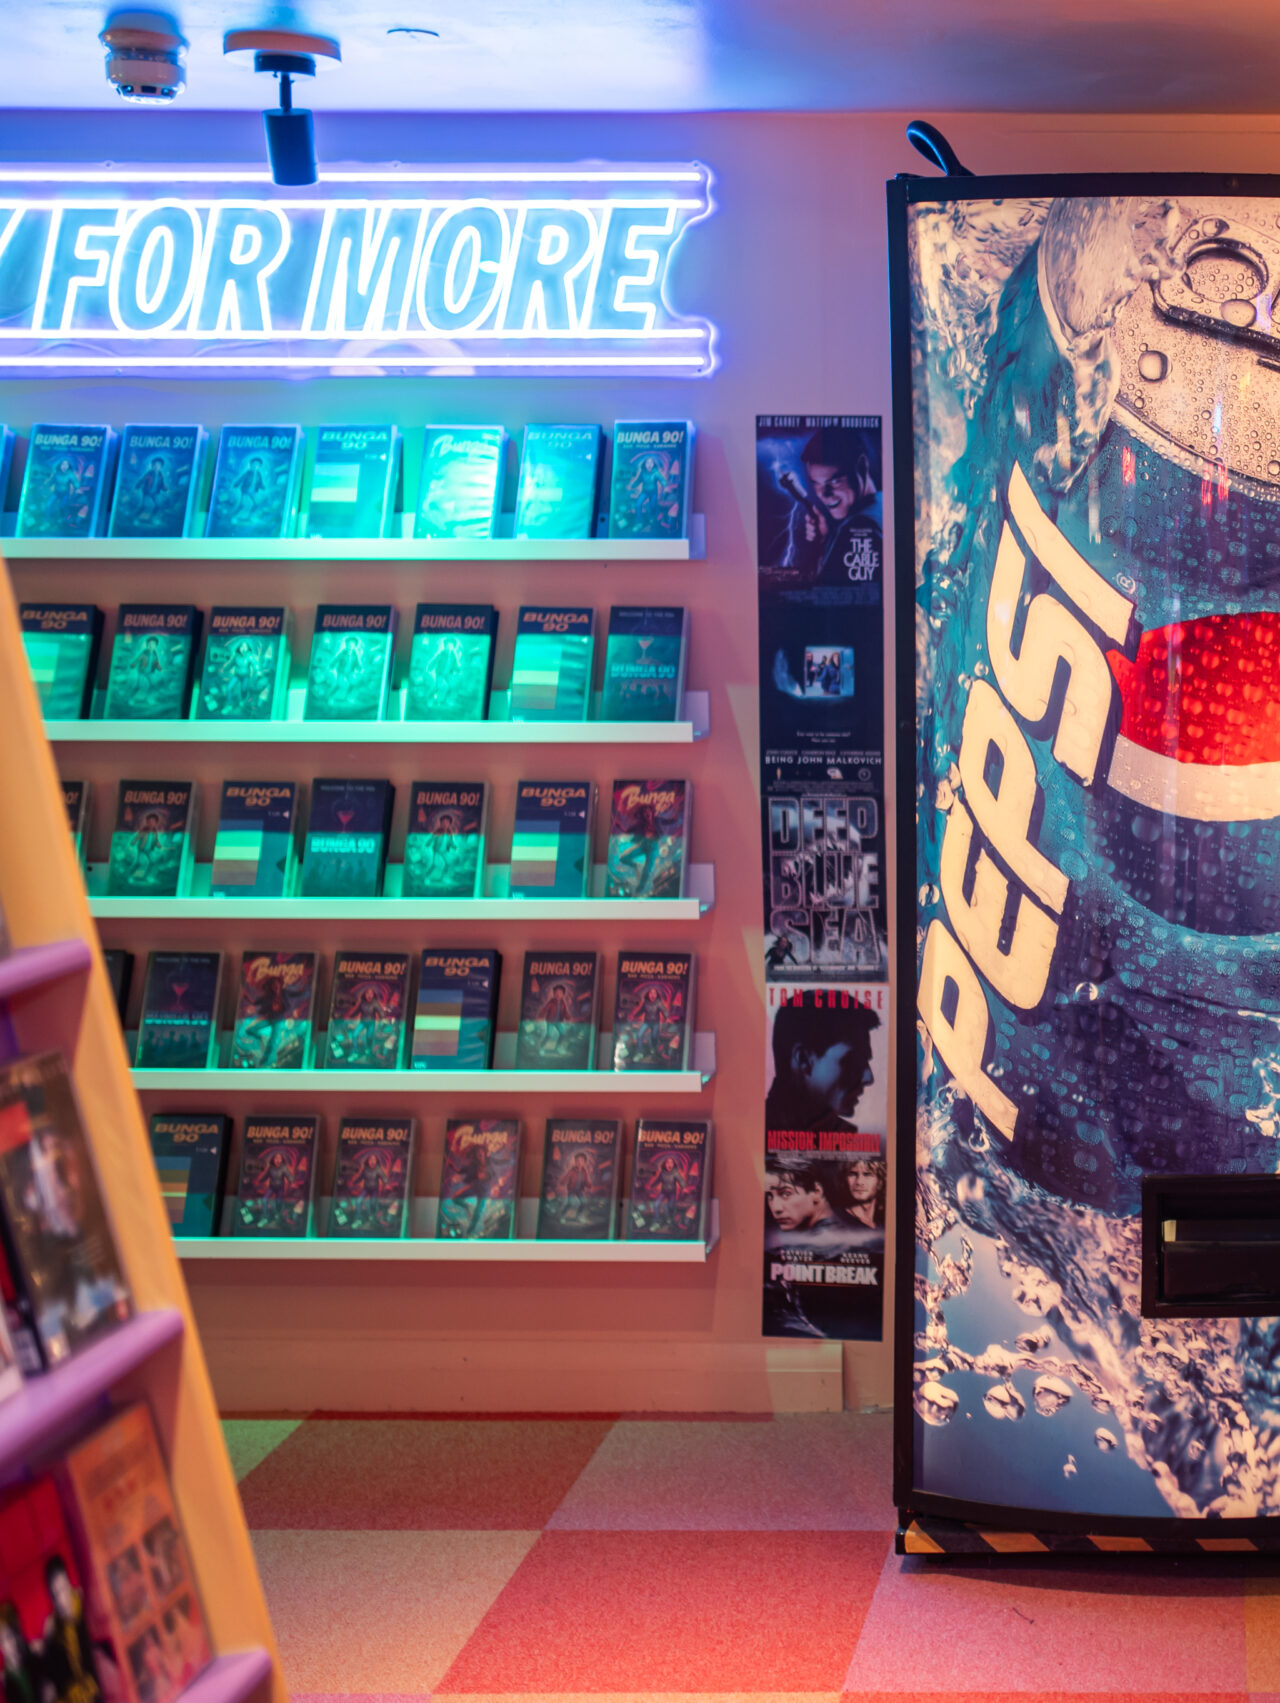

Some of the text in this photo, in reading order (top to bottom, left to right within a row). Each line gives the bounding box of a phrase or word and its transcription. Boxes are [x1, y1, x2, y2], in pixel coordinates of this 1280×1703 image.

[32, 198, 678, 338] FOR MORE
[34, 434, 103, 447] BUNGA 90!
[129, 435, 192, 449] BUNGA 90!
[228, 436, 291, 449] BUNGA 90!
[617, 430, 684, 444] BUNGA 90!
[850, 538, 872, 553] THE
[843, 552, 879, 567] CABLE
[848, 567, 875, 581] GUY
[22, 609, 88, 621] BUNGA
[124, 614, 188, 627] BUNGA 90!
[322, 615, 386, 628] BUNGA 90!
[523, 612, 589, 624] BUNGA
[212, 616, 280, 629] BUNGA 90!
[421, 615, 485, 630] BUNGA 90!
[542, 622, 569, 632] 90
[765, 756, 882, 766] BEING JOHN MALKOVICH
[124, 791, 187, 805] BUNGA 90!
[226, 787, 291, 798] BUNGA
[417, 792, 480, 806] BUNGA 90!
[521, 787, 587, 798] BUNGA
[620, 785, 676, 808] Bunga
[540, 796, 566, 807] 90
[917, 461, 1138, 1141] PEPSI
[768, 797, 878, 851] DEEP
[771, 851, 879, 909] BLUE
[770, 908, 880, 965] SEA
[251, 957, 304, 980] Bunga
[338, 961, 406, 975] BUNGA 90!
[425, 956, 490, 968] BUNGA
[530, 961, 592, 976] BUNGA 90!
[621, 960, 688, 975] BUNGA 90!
[444, 966, 469, 977] 90
[769, 988, 883, 1010] TOM CRUISE
[155, 1123, 219, 1134] BUNGA
[247, 1126, 313, 1139] BUNGA 90!
[341, 1127, 408, 1140] BUNGA 90!
[172, 1133, 198, 1143] 90
[455, 1125, 508, 1148] Bunga
[552, 1130, 614, 1144] BUNGA 90!
[638, 1130, 705, 1145] BUNGA 90!
[768, 1130, 880, 1153] MISSION: IMPOSSIBLE
[771, 1264, 878, 1285] POINT BREAK
